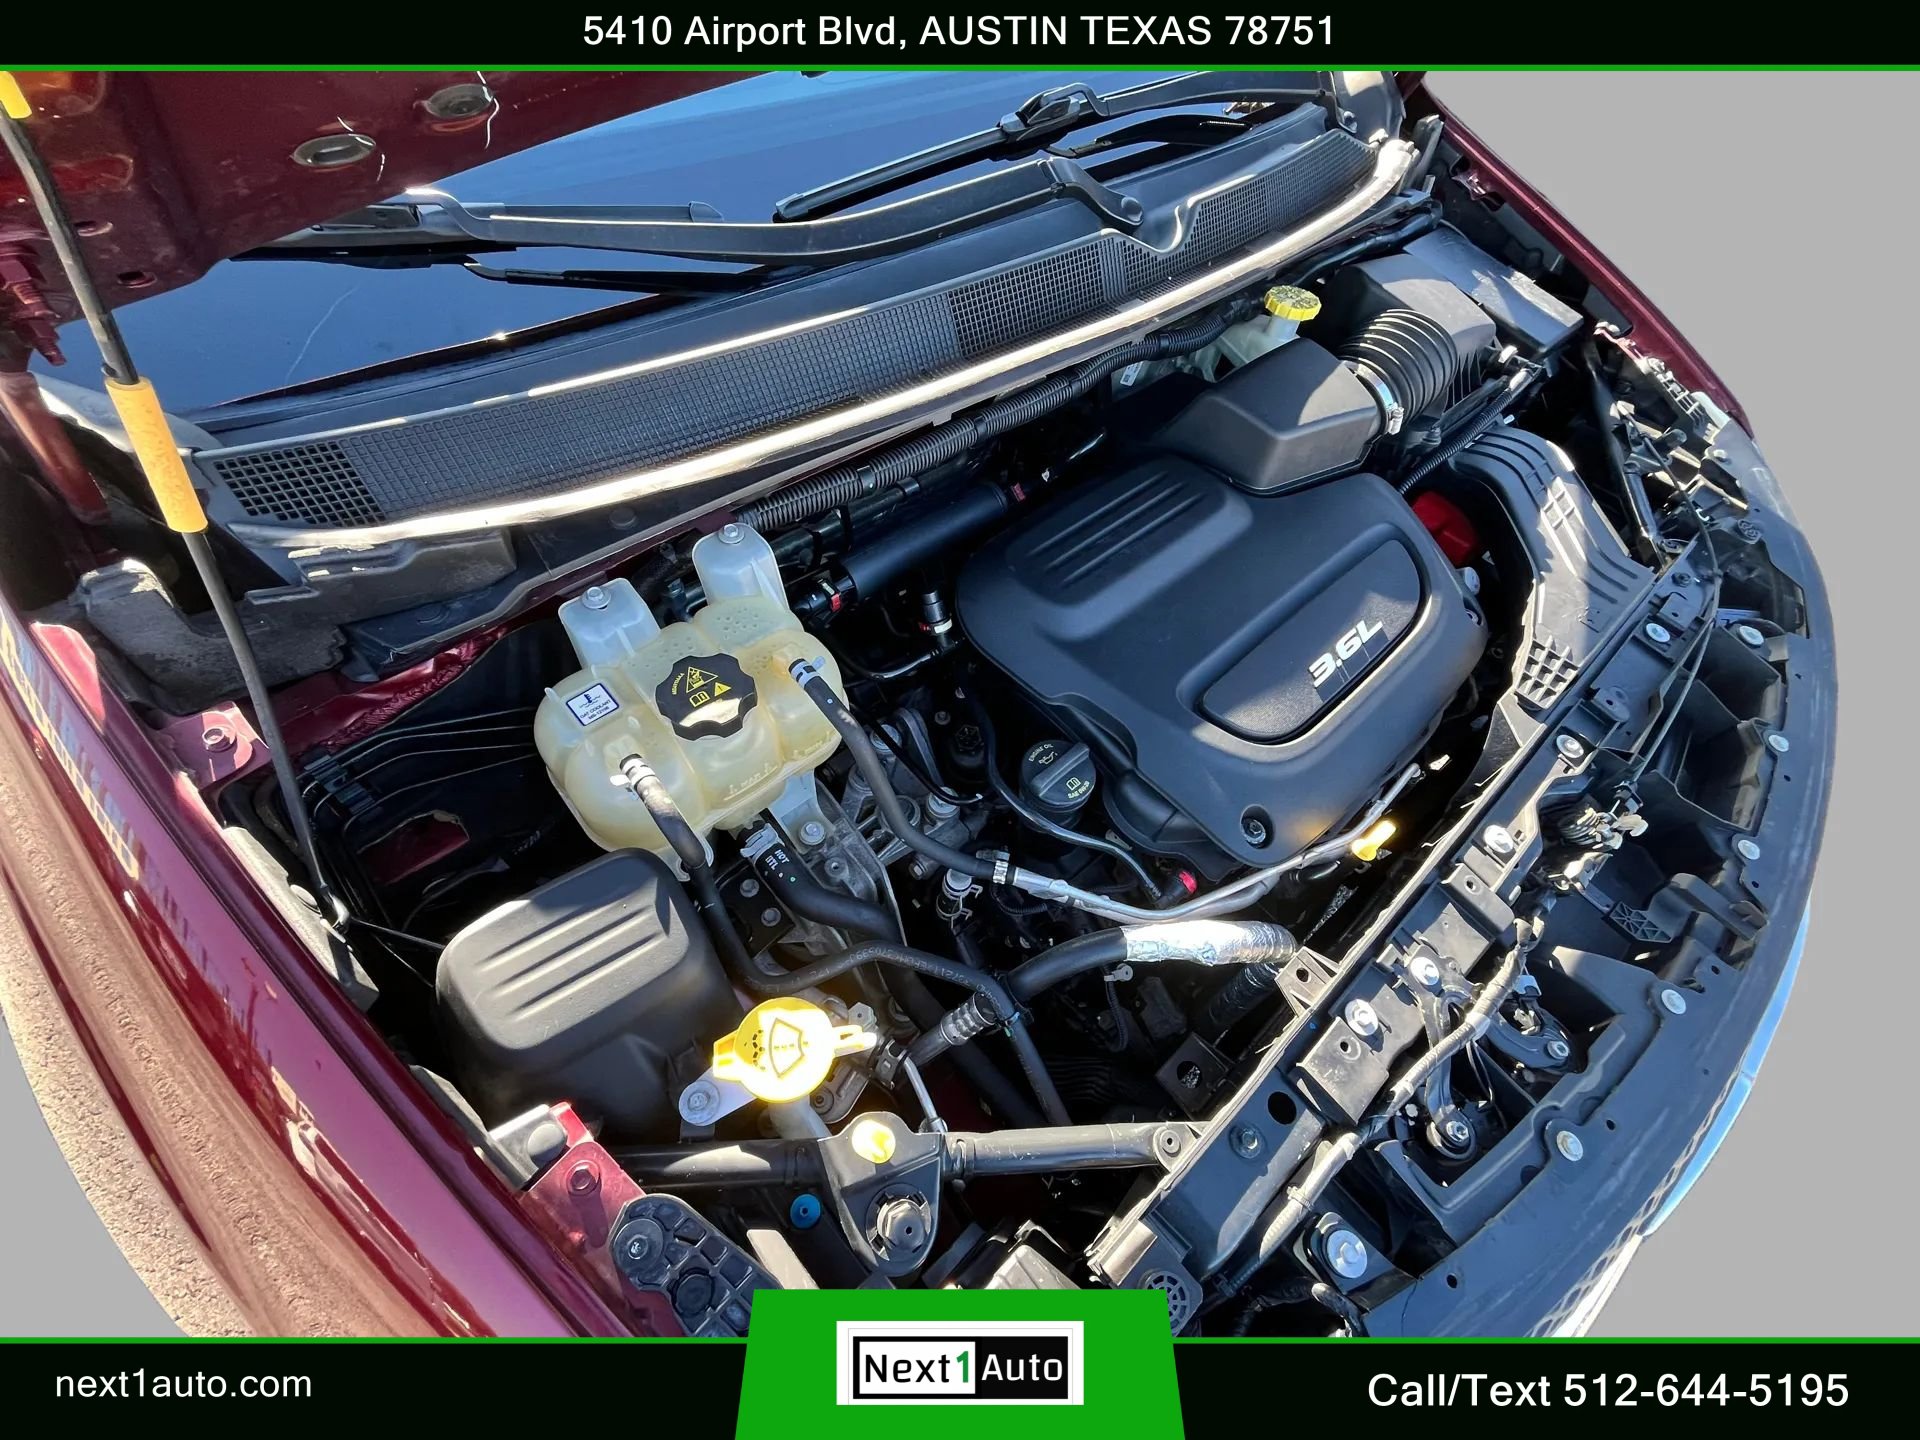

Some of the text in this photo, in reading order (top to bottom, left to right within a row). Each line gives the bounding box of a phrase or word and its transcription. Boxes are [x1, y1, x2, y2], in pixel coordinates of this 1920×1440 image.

[1308, 620, 1383, 688] 3.6L
[1028, 745, 1044, 762] ENGINE
[774, 849, 790, 864] HOT
